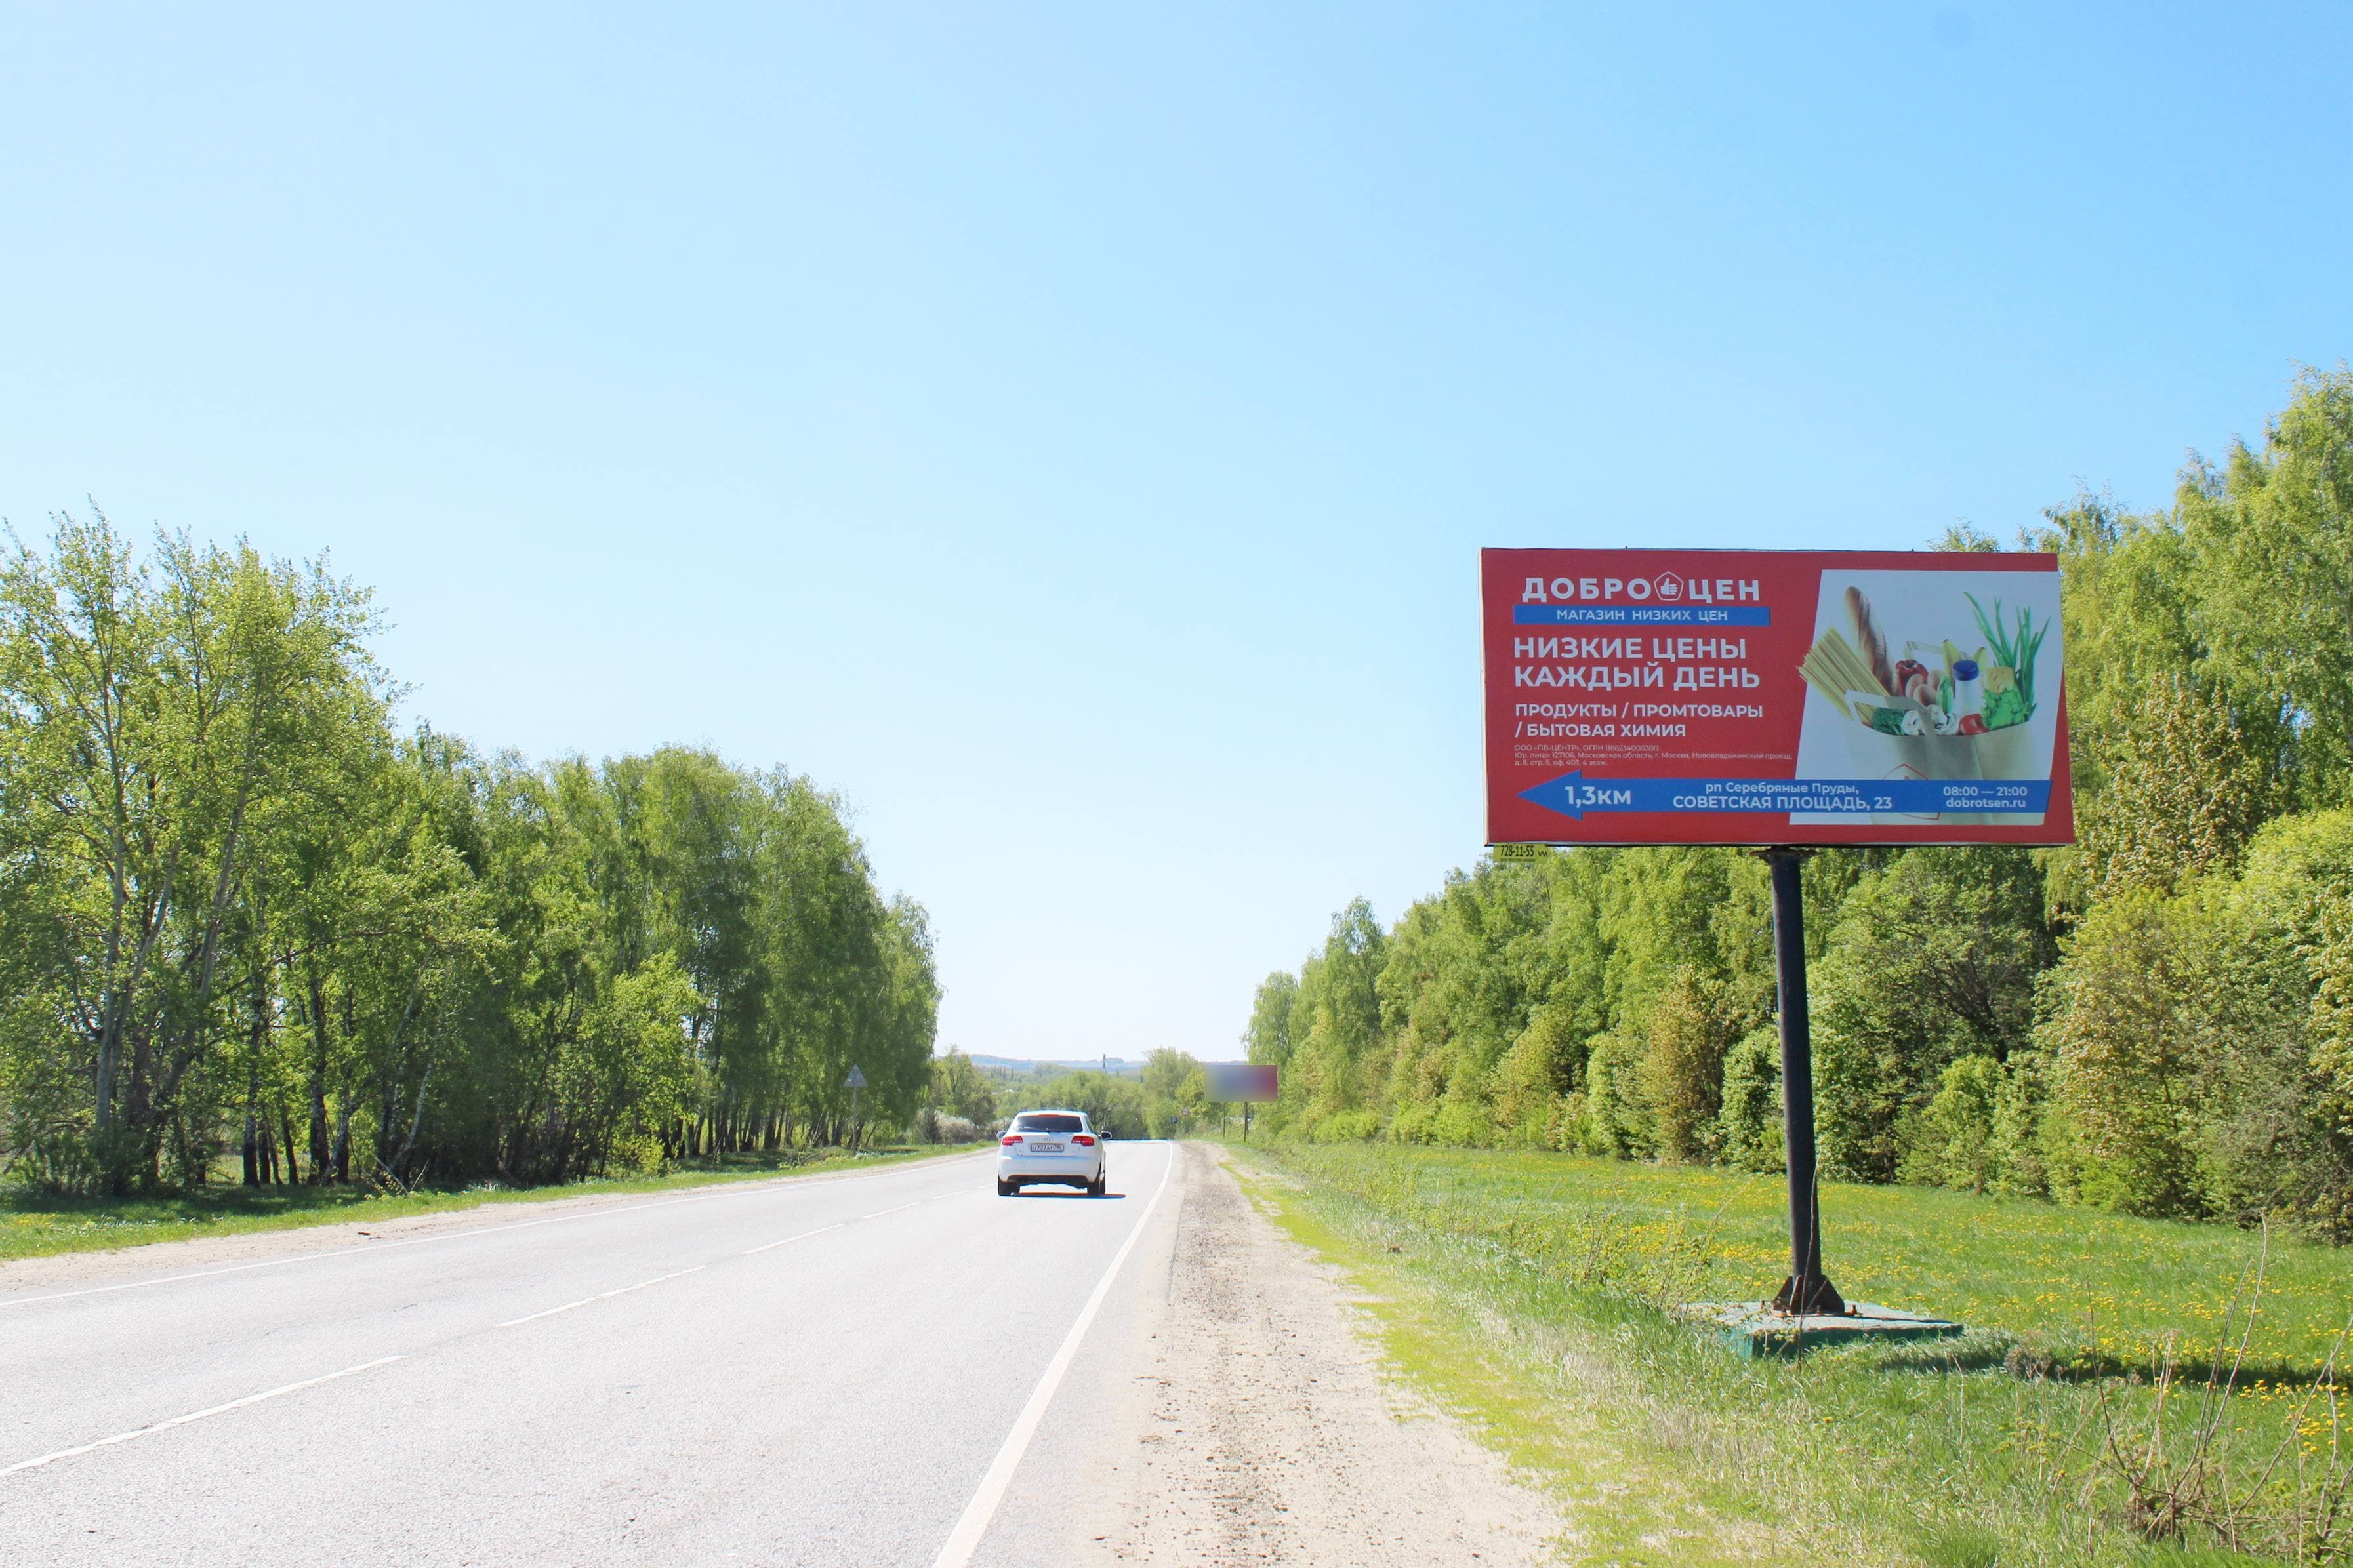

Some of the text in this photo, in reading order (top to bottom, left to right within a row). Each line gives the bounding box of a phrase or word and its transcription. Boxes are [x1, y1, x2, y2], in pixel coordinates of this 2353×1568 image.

[1522, 578, 1759, 603] ДОБРО ЦЕН
[1557, 610, 1727, 622] МАГАЗИН НИЗКИХ ЦЕН
[1515, 637, 1746, 664] НИЗКИЕ ЦЕНЫ
[1515, 662, 1759, 691] КАЖДЫЙ ДЕНЬ
[1516, 704, 1616, 719] ПРОДУКТЫ
[1634, 704, 1763, 717] ПРОМТОВАРЫ
[1528, 724, 1614, 736] БЫТОВАЯ
[1621, 724, 1685, 736] ХИМИЯ
[1706, 782, 1858, 795] рп Серебряные Пруды,
[1943, 786, 1978, 798] 08:00
[1996, 786, 2027, 796] 21:00
[1673, 796, 1892, 812] СОВЕТСКАЯ ПЛОЩАДЬ, 23
[1946, 797, 2025, 807] dobrotsen.ru
[1500, 845, 1535, 857] 728-11-55
